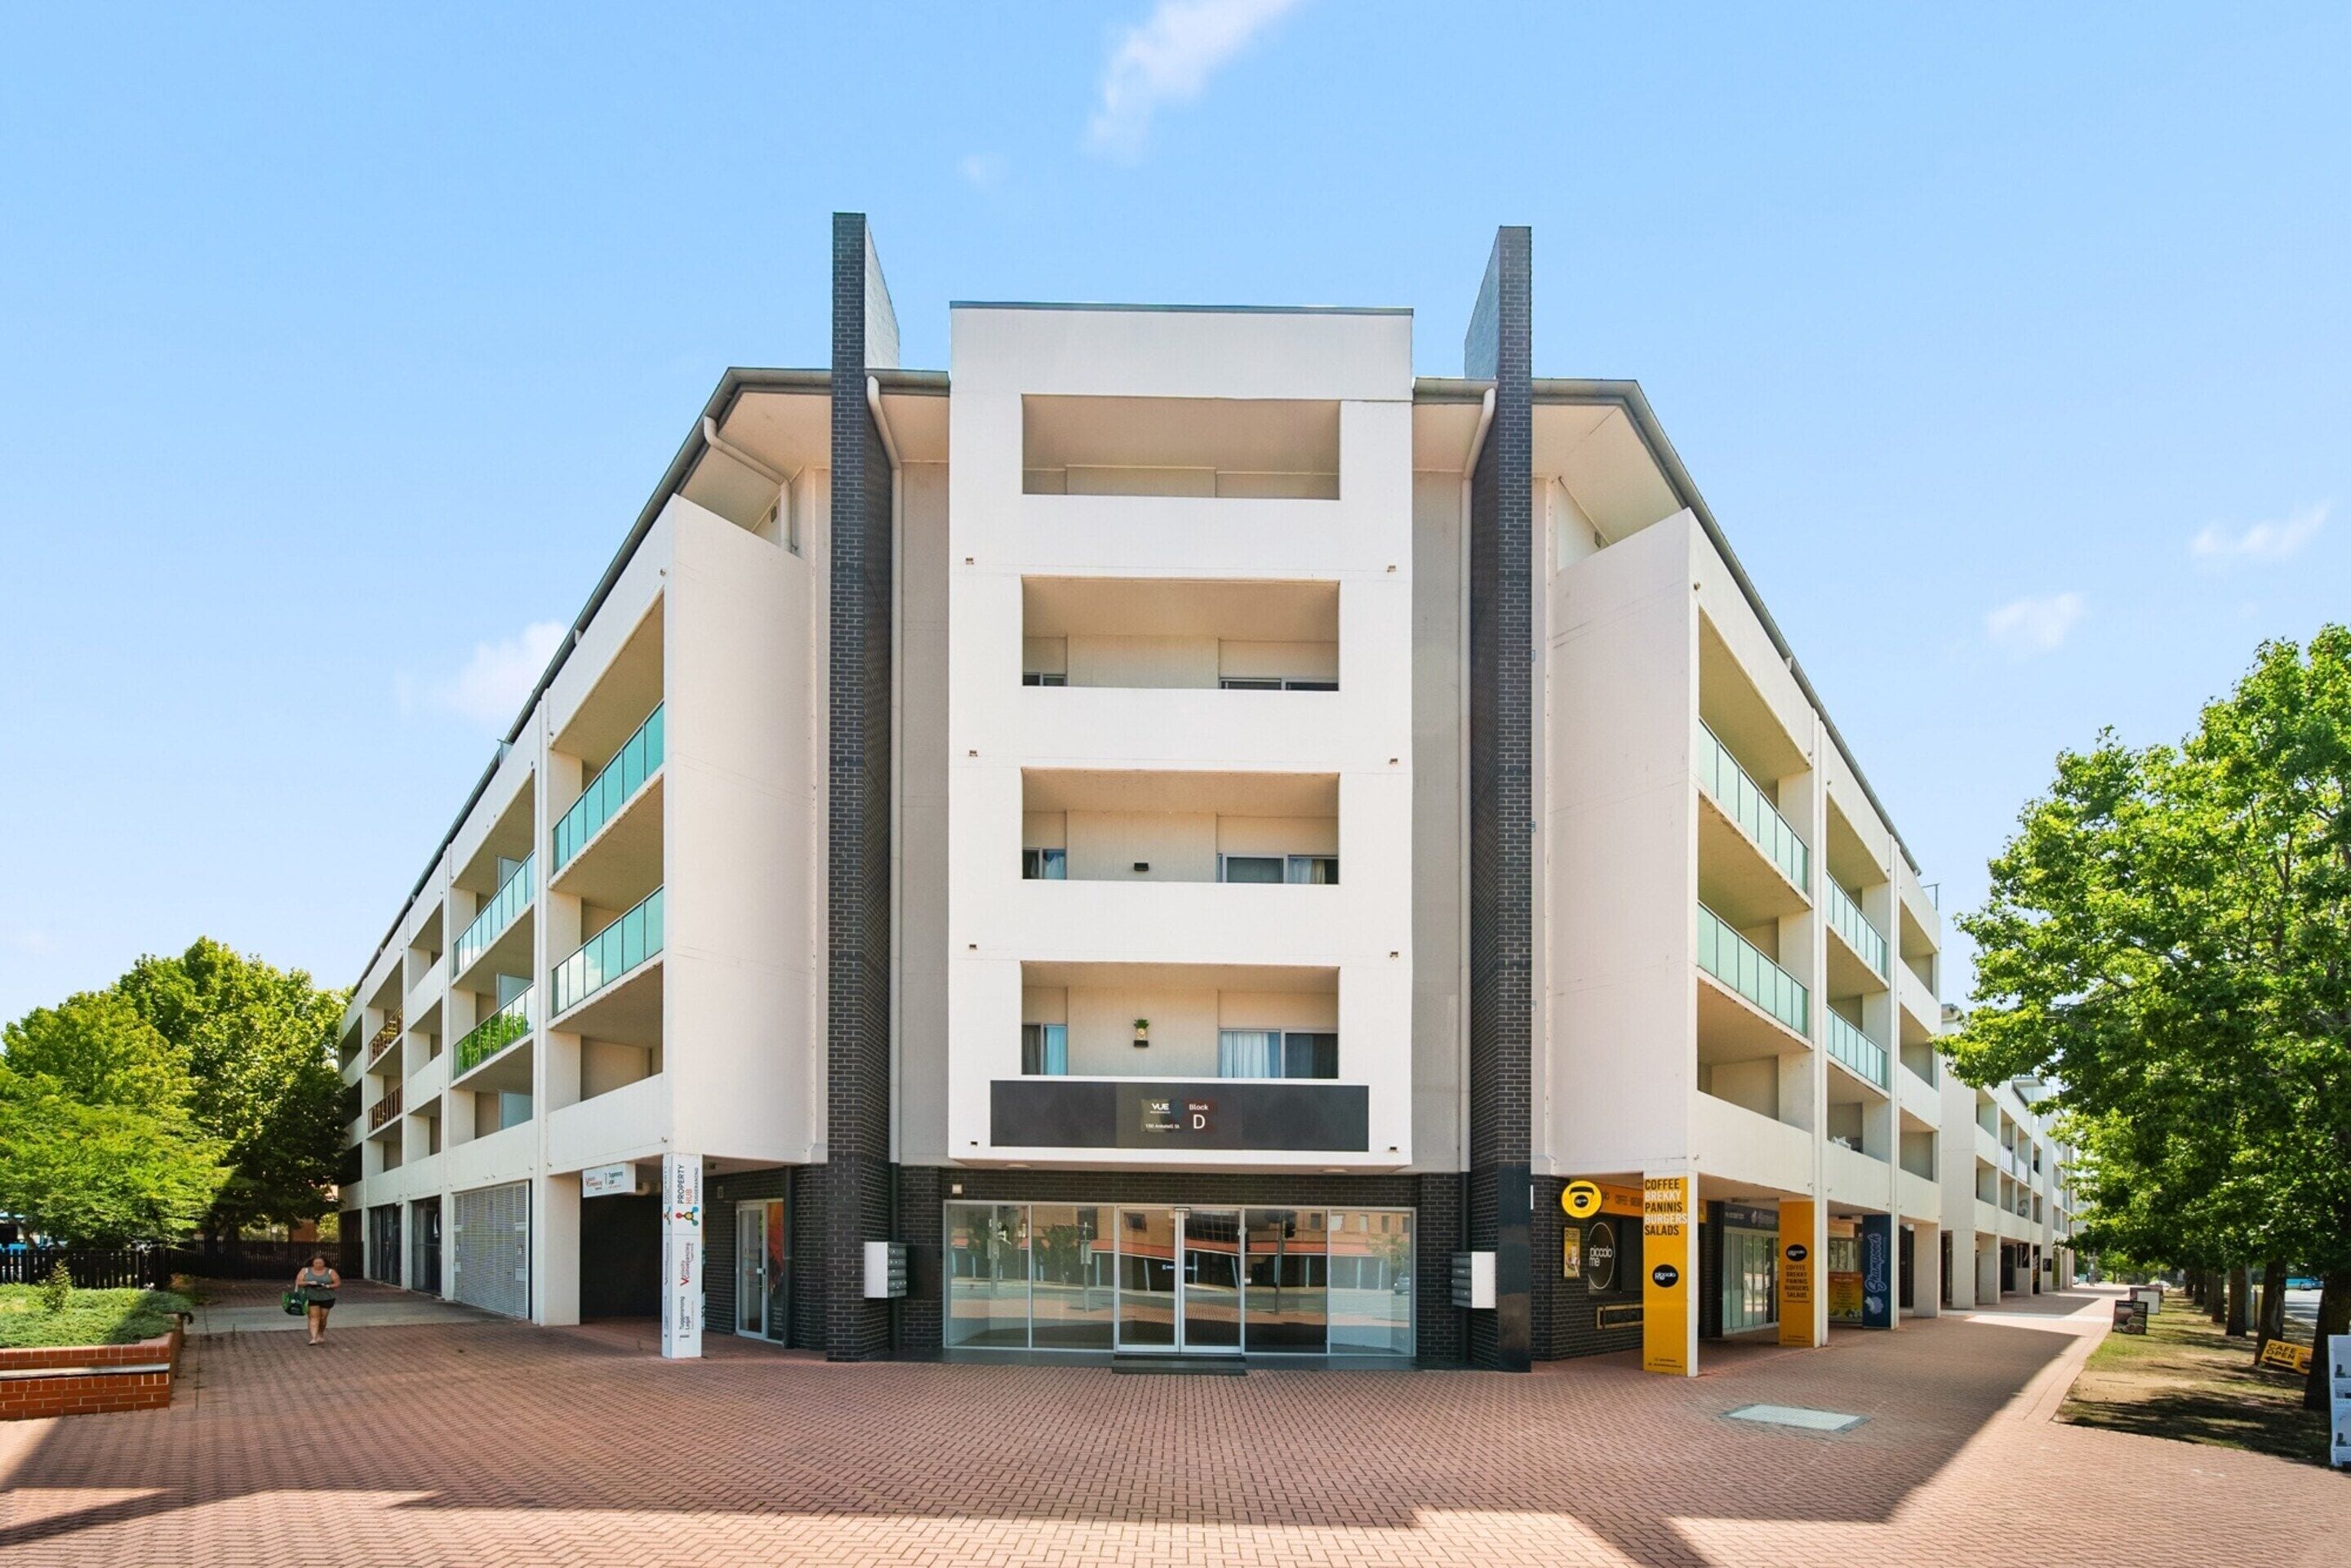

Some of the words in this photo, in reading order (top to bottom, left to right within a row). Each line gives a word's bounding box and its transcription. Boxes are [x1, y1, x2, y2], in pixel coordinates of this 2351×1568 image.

[1193, 1113, 1206, 1130] D
[1645, 1179, 1680, 1190] COFFEE
[1645, 1190, 1682, 1202] BREKKY
[1645, 1202, 1682, 1213] PANINIS
[1644, 1213, 1688, 1224] BURGERS
[1644, 1224, 1680, 1236] SALADS
[1589, 1245, 1612, 1258] piccolo
[1589, 1257, 1600, 1267] me
[2268, 1343, 2297, 1354] CAFE
[2266, 1349, 2295, 1360] OPEN
